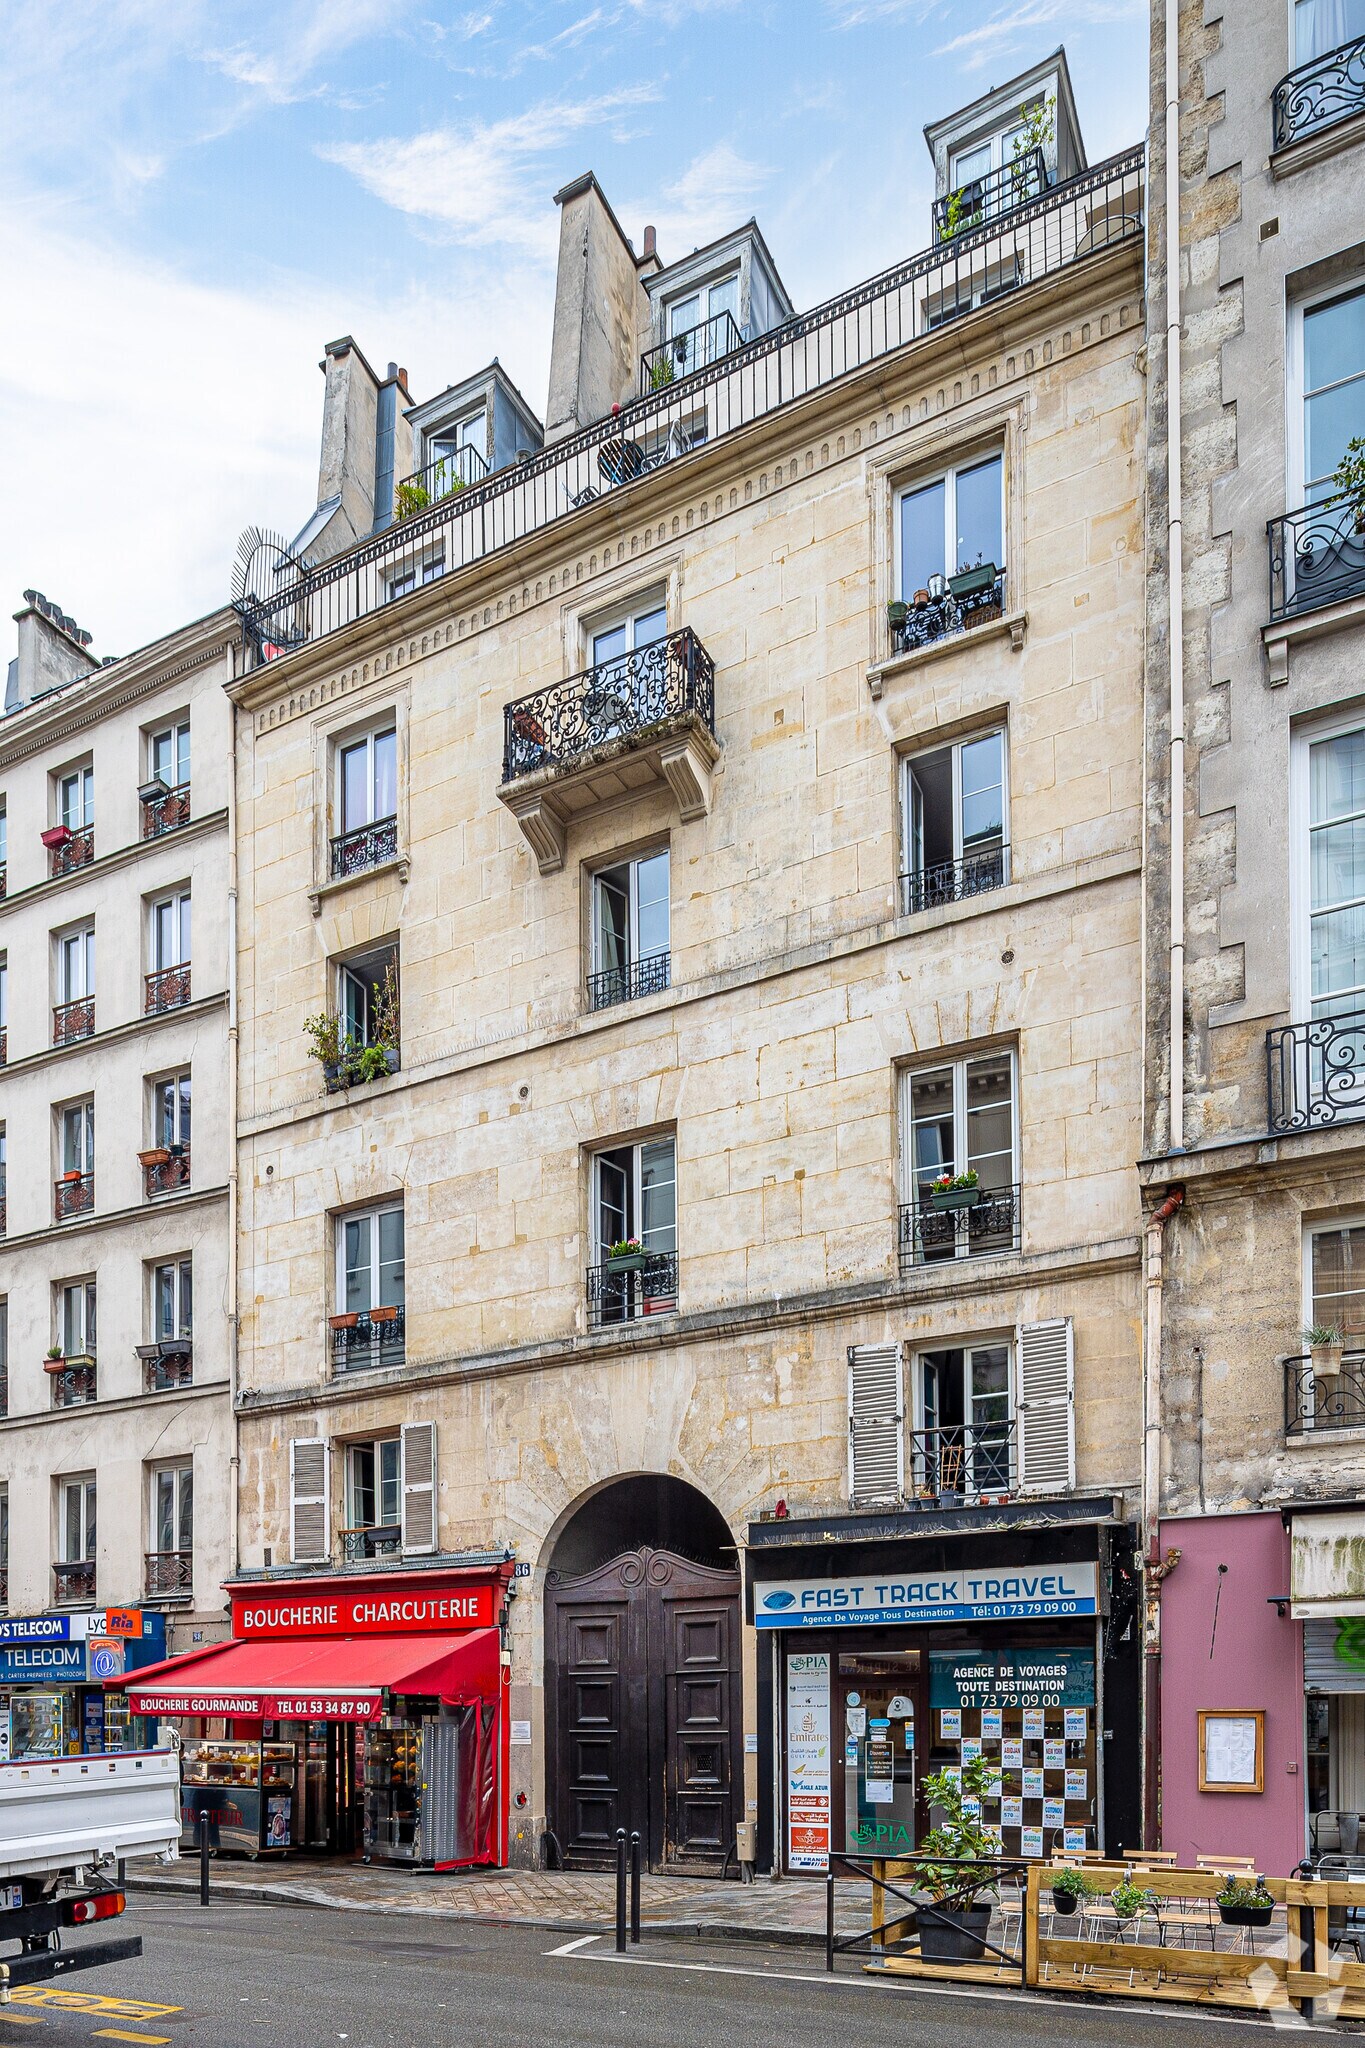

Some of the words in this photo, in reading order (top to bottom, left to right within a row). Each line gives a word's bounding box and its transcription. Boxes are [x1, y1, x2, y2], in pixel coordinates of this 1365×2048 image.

[516, 1564, 529, 1576] 86
[801, 1587, 864, 1608] FAST
[874, 1581, 958, 1604] TRACK
[968, 1576, 1075, 1599] TRAVEL
[111, 1613, 133, 1628] Ria
[243, 1605, 338, 1628] BOUCHERIE
[352, 1597, 479, 1623] CHARCUTERIE
[802, 1615, 832, 1625] Agence
[835, 1613, 847, 1622] De
[849, 1611, 880, 1623] Voyage
[882, 1610, 902, 1619] Tous
[904, 1607, 955, 1618] Destination
[972, 1606, 991, 1616] Tél:
[993, 1606, 1006, 1616] 01
[1010, 1605, 1024, 1615] 73
[1027, 1604, 1042, 1614] 79
[1044, 1602, 1059, 1613] 09
[1061, 1602, 1077, 1612] 00
[12, 1619, 63, 1637] TELECOM
[4, 1647, 80, 1667] TELECOM
[806, 1656, 828, 1668] PIA
[953, 1666, 994, 1678] AGENCE
[1000, 1666, 1014, 1677] DE
[1019, 1665, 1067, 1677] VOYAGES
[956, 1682, 990, 1692] TOUTE
[995, 1680, 1065, 1692] DESTINATION
[140, 1698, 190, 1711] BOUCHERIE
[191, 1699, 259, 1713] GOURMANDE
[277, 1701, 294, 1713] TEL
[295, 1701, 308, 1713] 01
[310, 1701, 323, 1714] 53
[325, 1702, 339, 1714] 34
[340, 1702, 354, 1714] 87
[356, 1702, 371, 1715] 90
[960, 1695, 975, 1708] 01
[981, 1695, 997, 1707] 73
[1001, 1695, 1018, 1707] 79
[1021, 1694, 1038, 1707] 09
[1042, 1694, 1060, 1707] 00
[789, 1732, 828, 1741] Emirates
[181, 1808, 243, 1825] TRTEUR
[876, 1824, 910, 1843] PIA
